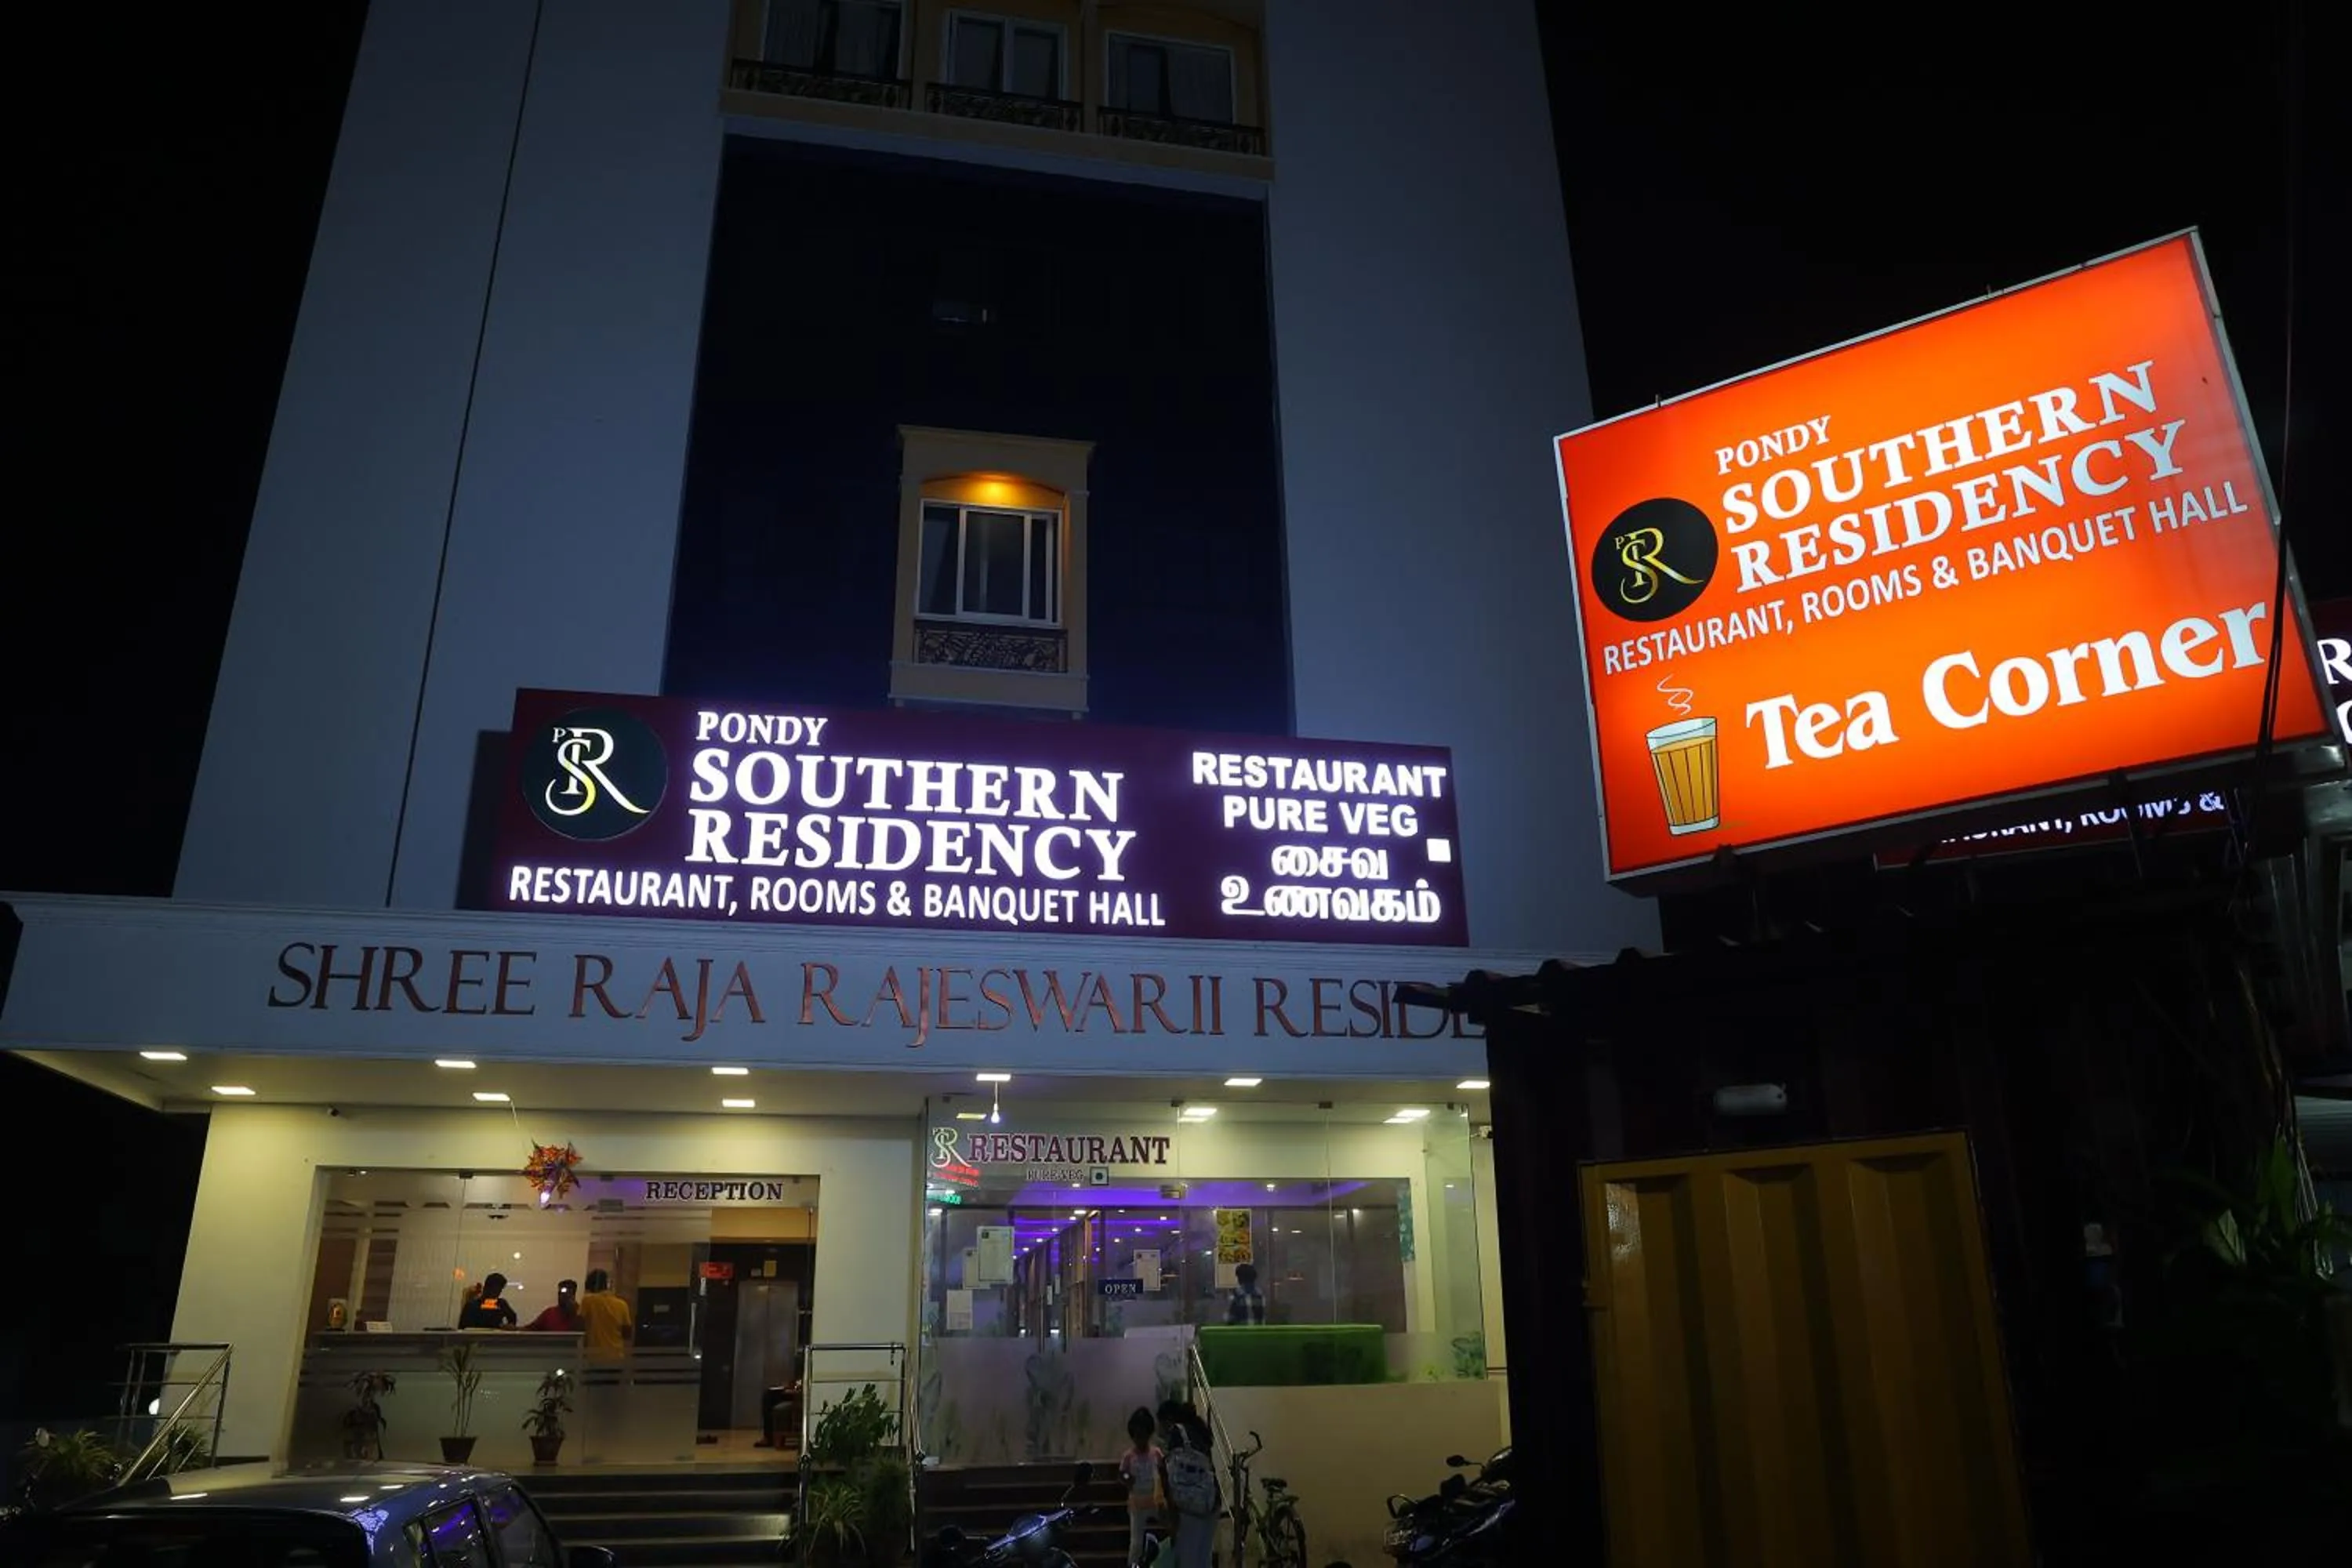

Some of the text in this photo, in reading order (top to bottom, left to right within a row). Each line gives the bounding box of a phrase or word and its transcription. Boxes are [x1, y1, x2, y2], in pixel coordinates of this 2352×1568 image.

[1715, 415, 1831, 475] PONDY
[1722, 360, 2157, 534] SOUTHERN
[1730, 419, 2186, 593] RESIDENCY
[1603, 480, 2249, 675] RESTAURANT, ROOMS & BANQUET HALL
[1745, 691, 1900, 769] Tea
[1922, 601, 2266, 729] Corner
[695, 711, 828, 746] PONDY
[689, 747, 1124, 822] SOUTHERN
[1192, 751, 1446, 798] RESTAURANT
[684, 808, 1136, 881] RESIDENCY
[1223, 795, 1418, 837] PURE VEG
[1271, 844, 1388, 880] சைவ
[509, 866, 1166, 926] RESTAURANT, ROOMS & BANQUET HALL
[1221, 875, 1441, 923] உணவகம்
[267, 942, 537, 1015] SHREE
[568, 954, 767, 1042] RAJA
[797, 962, 1225, 1048] RAJESWARII
[967, 1133, 1171, 1164] RESTAURANT
[645, 1181, 784, 1201] RECEPTION
